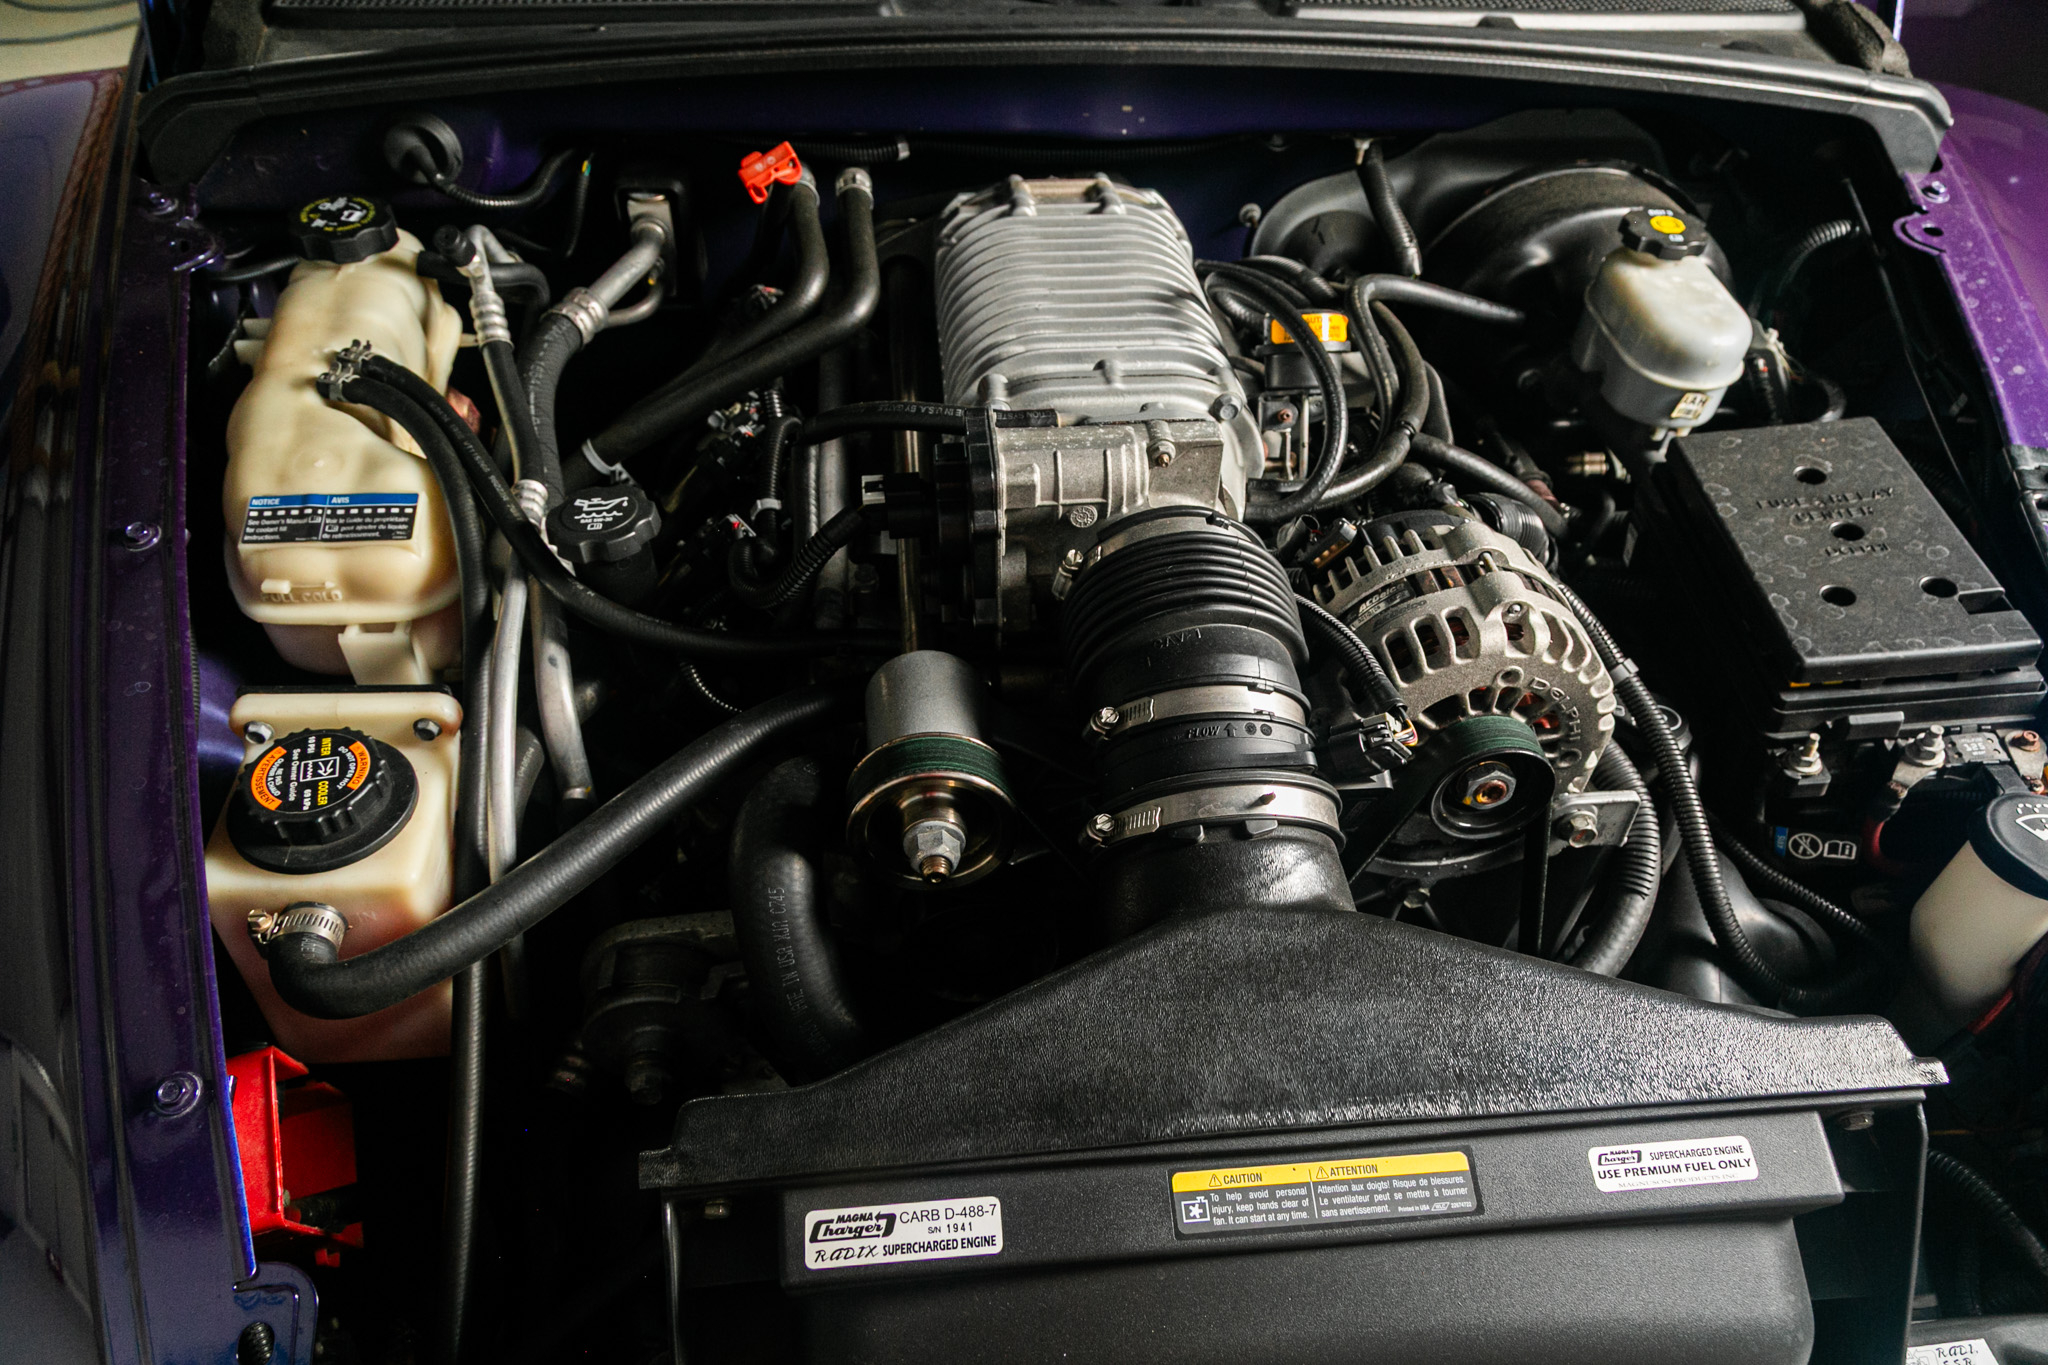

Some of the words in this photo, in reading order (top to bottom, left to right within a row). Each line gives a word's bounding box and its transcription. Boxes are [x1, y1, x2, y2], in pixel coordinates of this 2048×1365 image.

[252, 497, 281, 506] NOTICE
[331, 496, 350, 504] AVIS
[1755, 496, 1810, 511] FUSE
[1827, 486, 1896, 505] RELAY
[286, 517, 308, 525] Manual
[355, 525, 378, 533] ajouter
[302, 588, 344, 604] COLD
[1188, 725, 1221, 739] FLOW
[292, 748, 301, 760] See
[307, 743, 316, 754] PSI
[320, 737, 332, 756] INTER
[1963, 742, 1986, 752] 125
[345, 751, 356, 763] NOT
[267, 758, 284, 777] OUVRIR
[277, 768, 284, 776] NE
[290, 761, 299, 781] Owner
[347, 762, 357, 779] OPEN
[352, 751, 367, 786] WARNING
[255, 755, 276, 806] AVERTISSEMENT
[275, 776, 283, 786] PAS
[337, 777, 350, 790] HOT
[267, 781, 281, 797] CHAUD
[288, 782, 298, 802] Guide
[303, 789, 312, 798] 69
[317, 781, 329, 806] COOLER
[302, 798, 312, 811] kPa
[767, 886, 786, 915] C745
[776, 945, 797, 969] USA
[783, 971, 801, 987] IN
[1649, 1147, 1713, 1161] SUPERCHARGED
[1714, 1144, 1745, 1155] ENGINE
[1329, 1163, 1379, 1177] ATTENTION
[1598, 1168, 1621, 1180] USE
[1624, 1163, 1682, 1178] PREMIUM
[1685, 1160, 1717, 1173] FUEL
[1718, 1157, 1752, 1170] ONLY
[1223, 1172, 1263, 1185] CAUTION
[1317, 1183, 1349, 1195] Attention
[1351, 1183, 1365, 1193] aux
[1366, 1180, 1390, 1193] doigts!
[1392, 1178, 1417, 1190] Risque
[1419, 1177, 1429, 1187] de
[1430, 1175, 1466, 1187] blessures.
[1618, 1179, 1672, 1189] MAGNUSON
[1673, 1175, 1721, 1185] PRODUCTS
[1209, 1193, 1222, 1203] To
[1225, 1192, 1243, 1204] help
[1249, 1189, 1270, 1200] avoid
[1276, 1186, 1308, 1199] personal
[1319, 1196, 1329, 1206] Le
[1332, 1193, 1371, 1205] ventilateur
[1374, 1192, 1391, 1204] peut
[1393, 1192, 1404, 1201] se
[1406, 1188, 1430, 1200] mettre
[1433, 1187, 1440, 1197] à
[1442, 1186, 1469, 1196] tourner
[899, 1210, 941, 1224] CARB
[944, 1203, 998, 1221] D-488-7
[1212, 1203, 1234, 1216] injury,
[1236, 1201, 1254, 1213] keep
[1256, 1199, 1279, 1210] hands
[1281, 1198, 1299, 1208] clear
[1300, 1198, 1310, 1207] of
[1321, 1208, 1339, 1218] sans
[1339, 1204, 1391, 1217] avertissement.
[1398, 1205, 1414, 1213] Printed
[1419, 1203, 1430, 1212] USA
[836, 1211, 874, 1224] MAGNA
[1213, 1216, 1228, 1227] fan.
[1228, 1215, 1235, 1225] It
[1235, 1215, 1249, 1224] can
[1250, 1212, 1267, 1223] start
[1268, 1212, 1276, 1222] at
[1276, 1212, 1291, 1223] any
[1291, 1209, 1310, 1220] time.
[809, 1213, 897, 1243] Charger
[927, 1225, 943, 1235] S/N
[946, 1221, 974, 1234] 1941
[814, 1244, 880, 1263] RADIX
[882, 1237, 959, 1257] SUPERCHARGED
[960, 1234, 997, 1250] ENGINE
